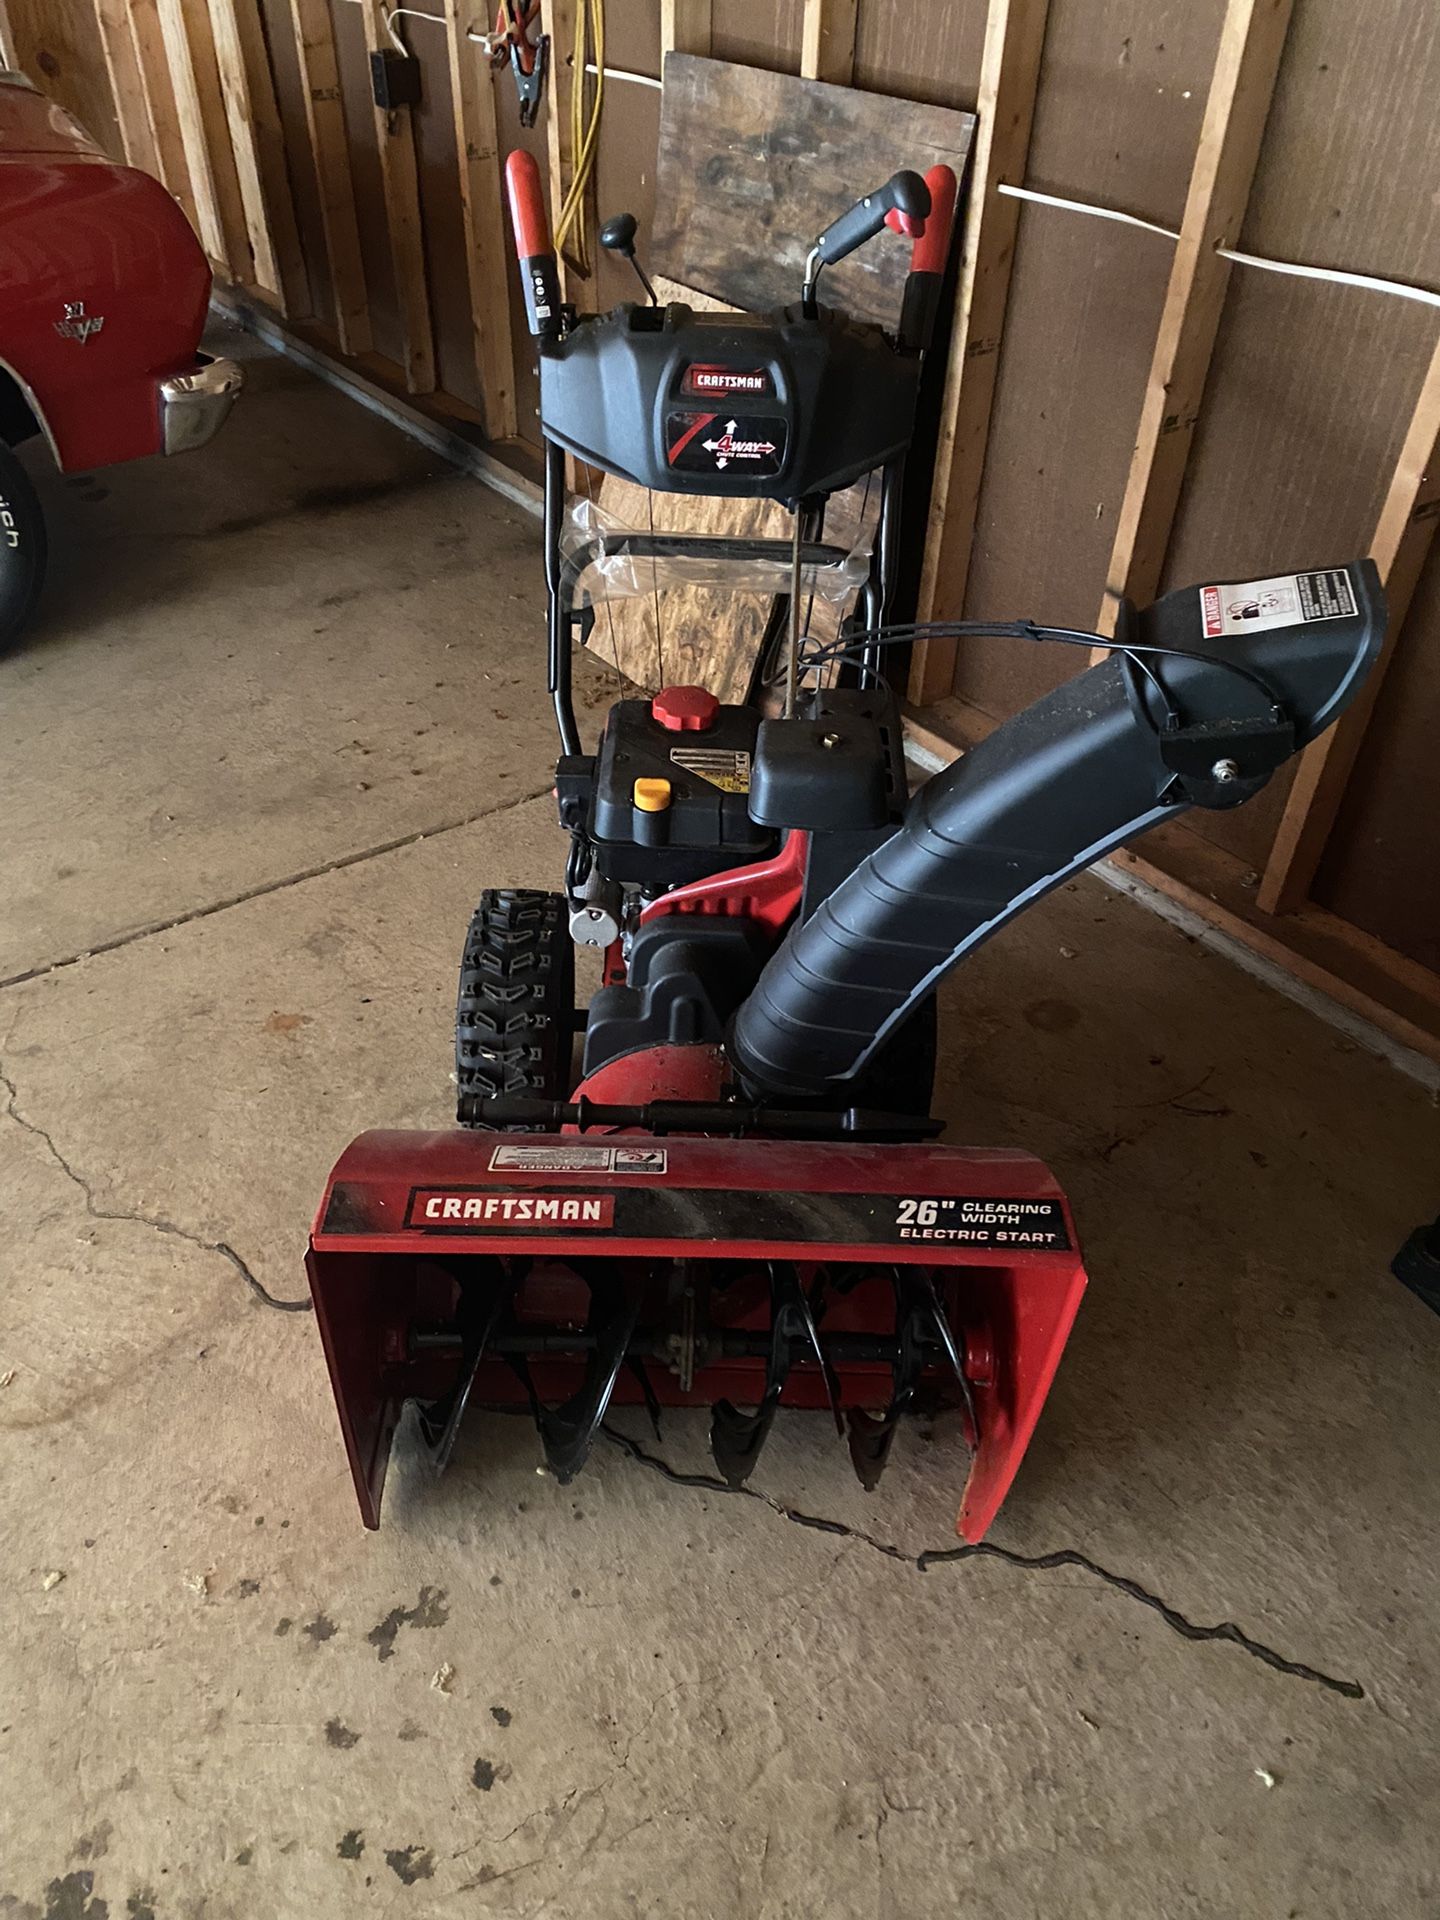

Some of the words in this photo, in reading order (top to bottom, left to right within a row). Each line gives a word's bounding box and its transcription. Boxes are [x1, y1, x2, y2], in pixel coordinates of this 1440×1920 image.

[697, 374, 762, 388] CRAFTSMAN
[0, 494, 19, 548] ich
[1205, 591, 1220, 621] DANGER
[425, 1197, 600, 1220] CRAFTSMAN
[895, 1199, 956, 1226] 26"
[962, 1202, 1052, 1214] CLEARING
[960, 1213, 1020, 1224] WIDTH
[900, 1228, 990, 1241] ELECTRIC
[996, 1232, 1056, 1242] START
